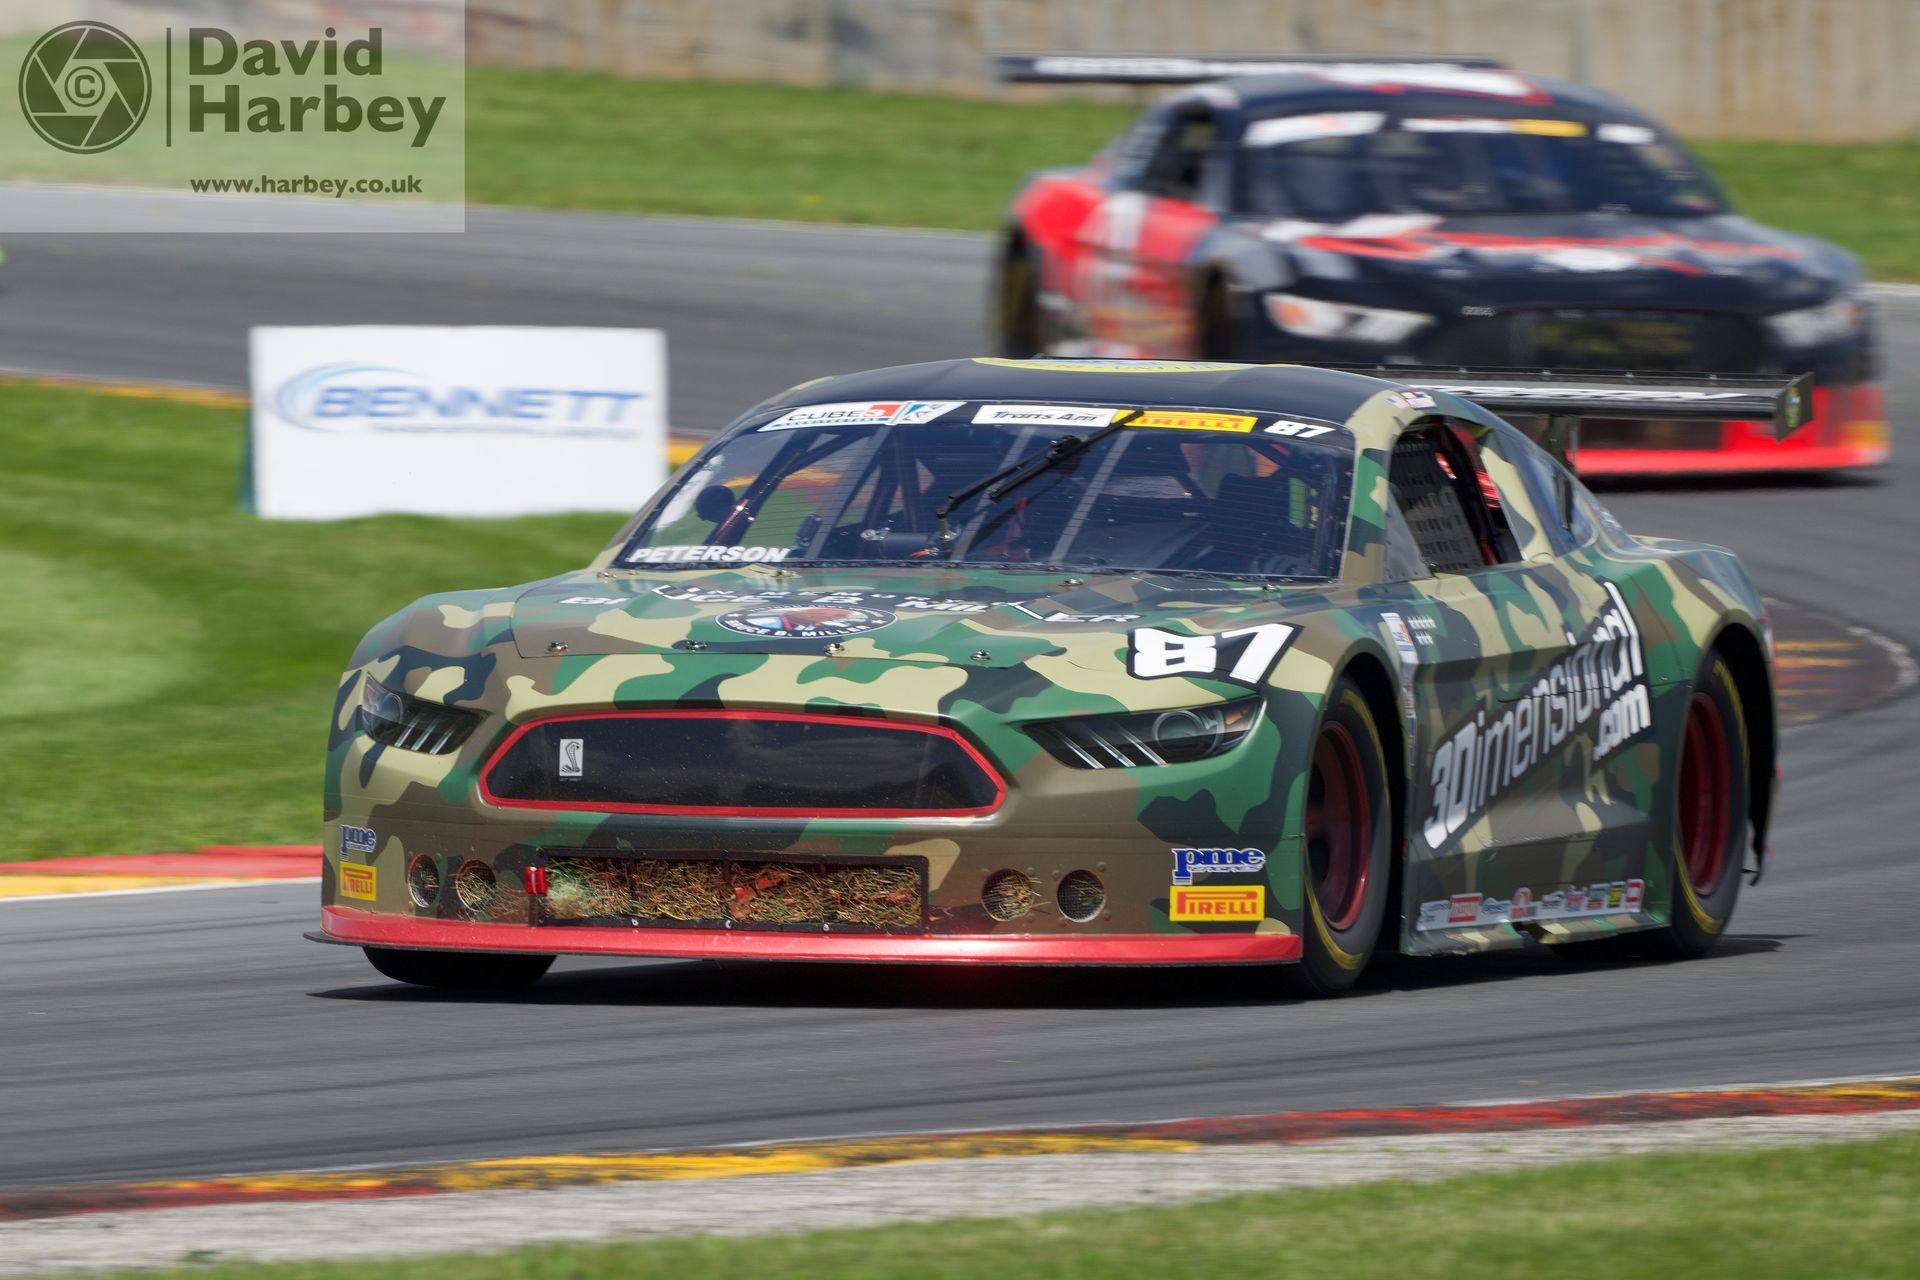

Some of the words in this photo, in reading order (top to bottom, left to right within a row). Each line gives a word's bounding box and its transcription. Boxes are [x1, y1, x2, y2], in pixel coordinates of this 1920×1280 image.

[313, 385, 646, 422] BENNETT
[992, 411, 1053, 420] Trans
[1056, 413, 1098, 422] Am
[1264, 420, 1336, 438] 87
[626, 545, 791, 563] PETERSON
[802, 624, 872, 638] MILLER
[1131, 622, 1298, 686] 87
[1423, 582, 1644, 849] 3Dimensional
[1592, 683, 1652, 762] .com
[340, 824, 377, 861] pme
[343, 867, 374, 896] PIRELLI
[1171, 848, 1265, 885] pme
[1176, 891, 1258, 915] PIRELLI
